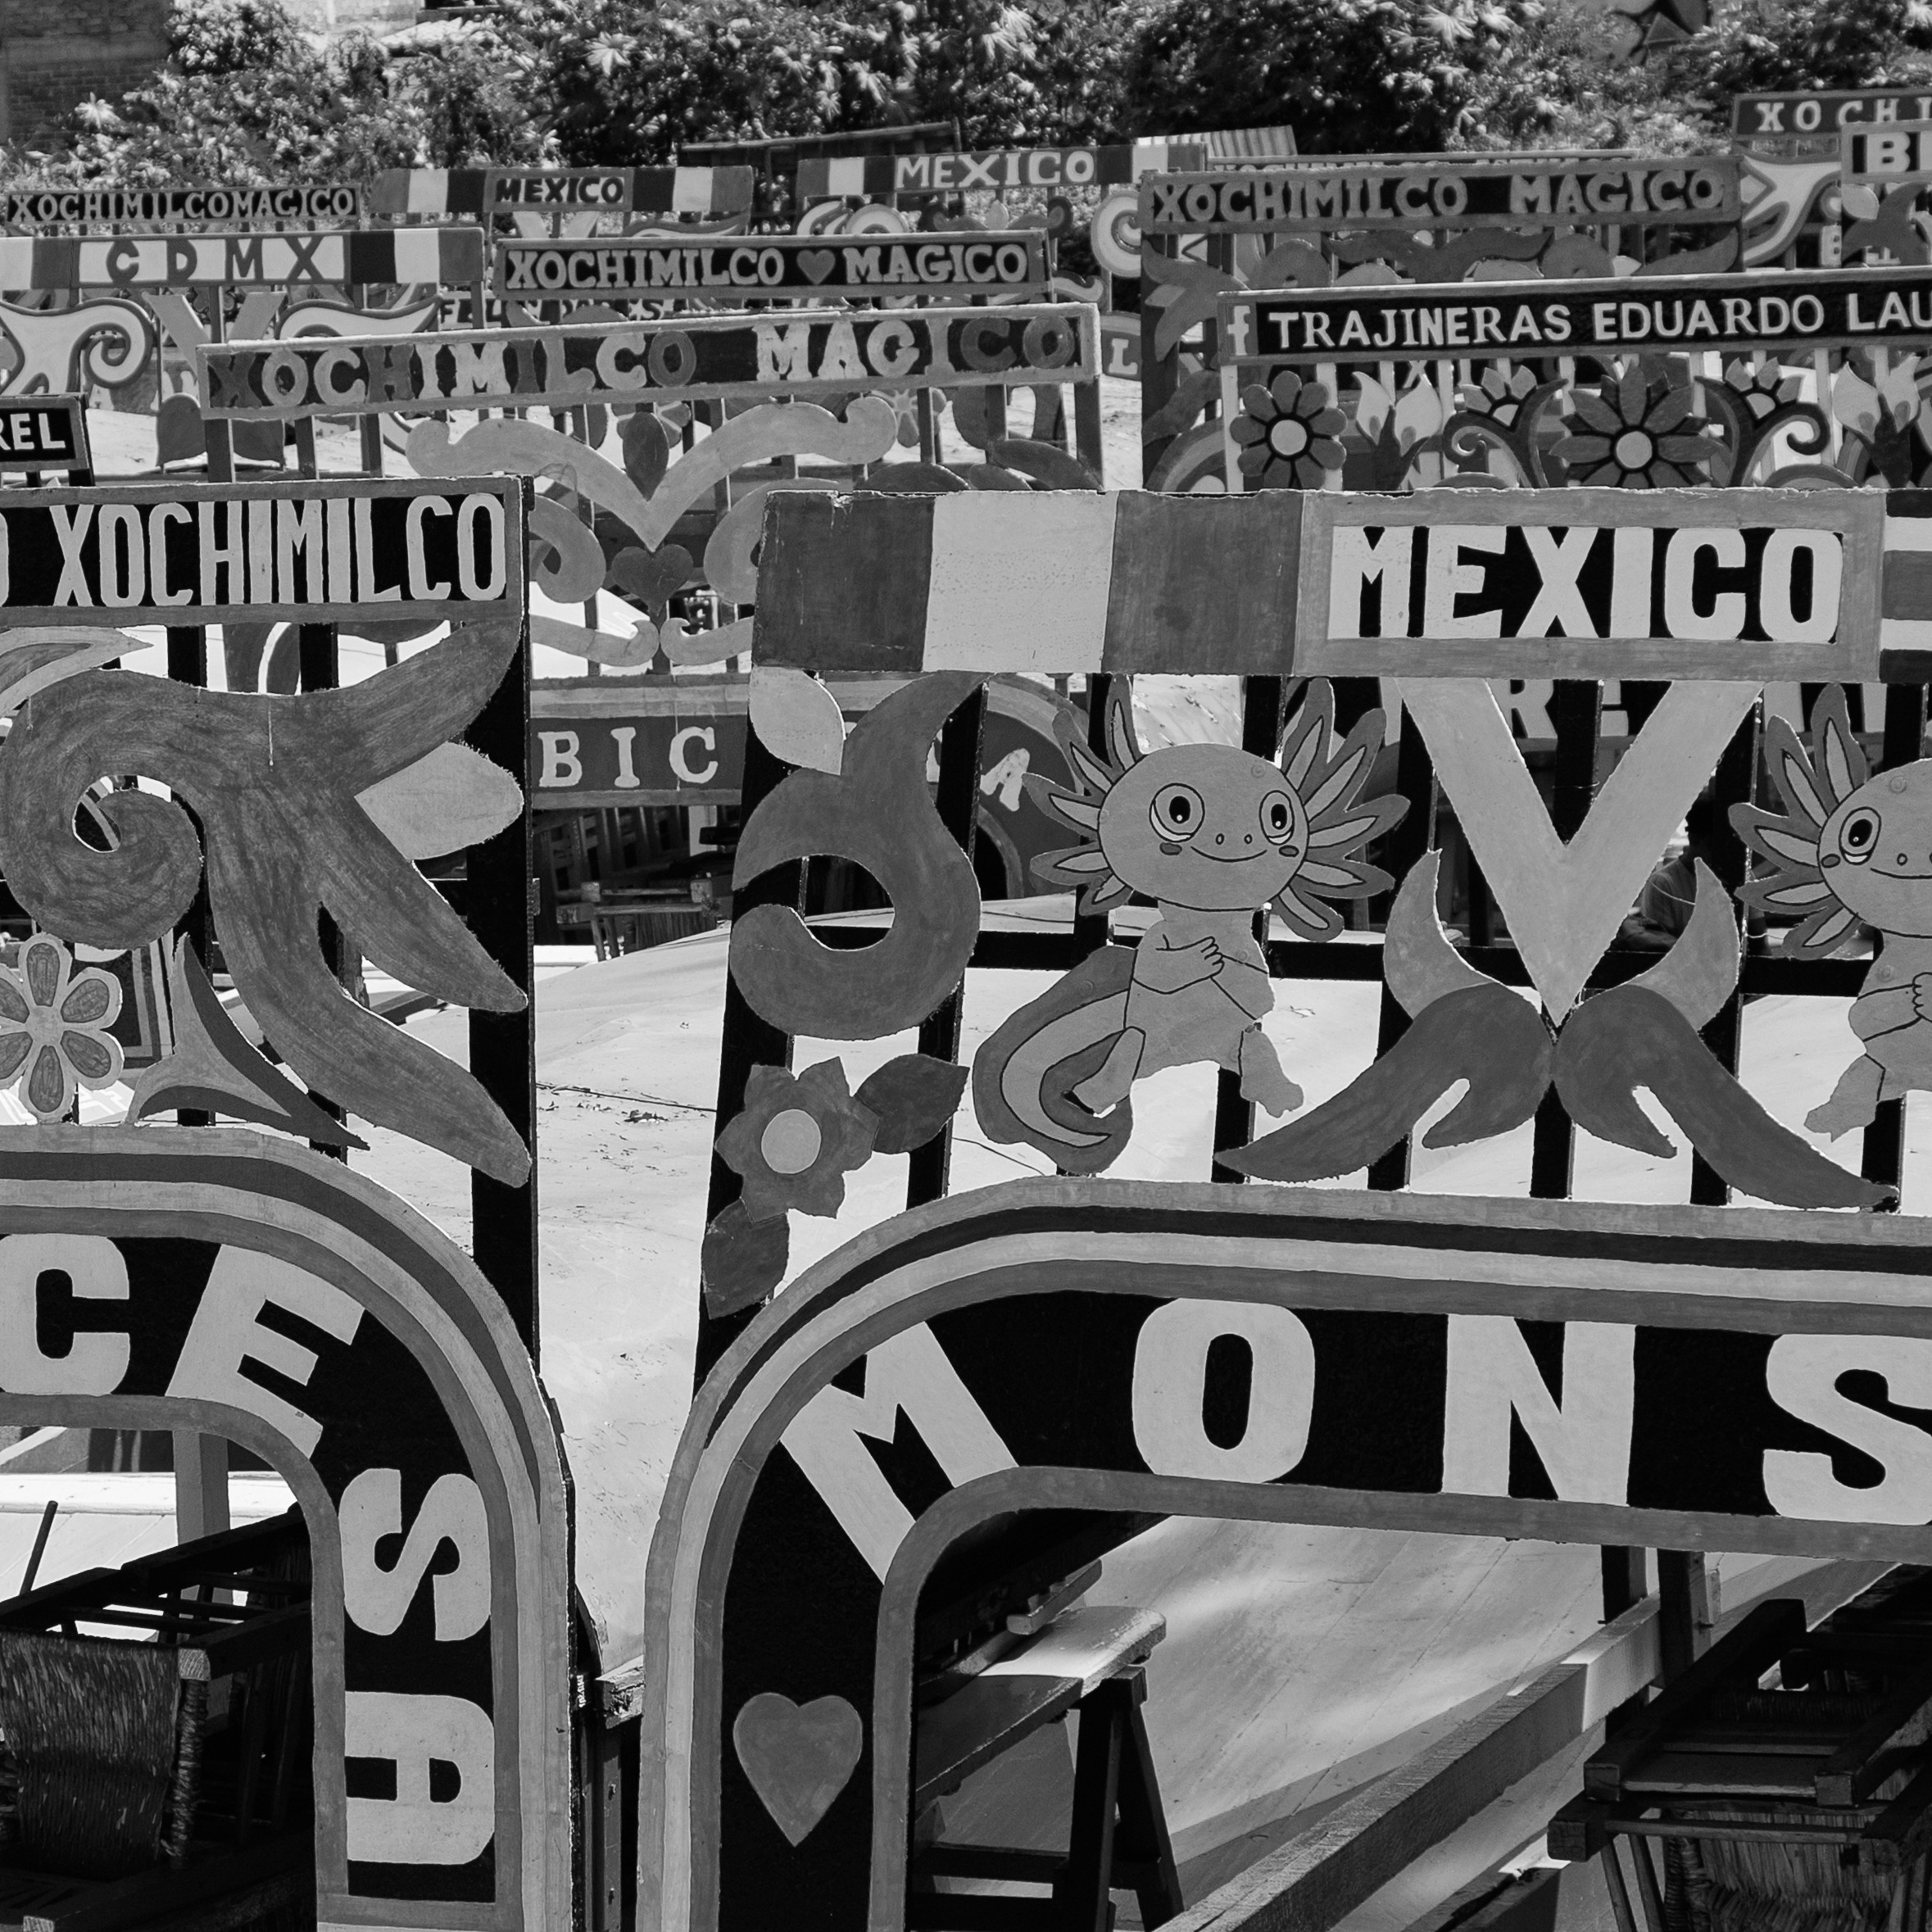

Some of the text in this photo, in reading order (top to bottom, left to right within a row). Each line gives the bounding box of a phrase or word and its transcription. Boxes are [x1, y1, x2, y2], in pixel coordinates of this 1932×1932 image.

[495, 175, 625, 204] MEXICO
[896, 149, 1095, 189] MEXICO
[1154, 169, 1724, 223] XOCHIMILCO MAGICO
[506, 243, 1028, 290] XOCHIMILCO MAGICO
[1268, 304, 1571, 349] TRAJINERAS
[1594, 293, 1825, 340] EDUARDO
[208, 329, 698, 407] XOCHIMILCO
[752, 315, 1075, 383] MAGICO
[49, 493, 506, 607] XOCHIMILCO
[1329, 526, 1844, 644] MEXICO
